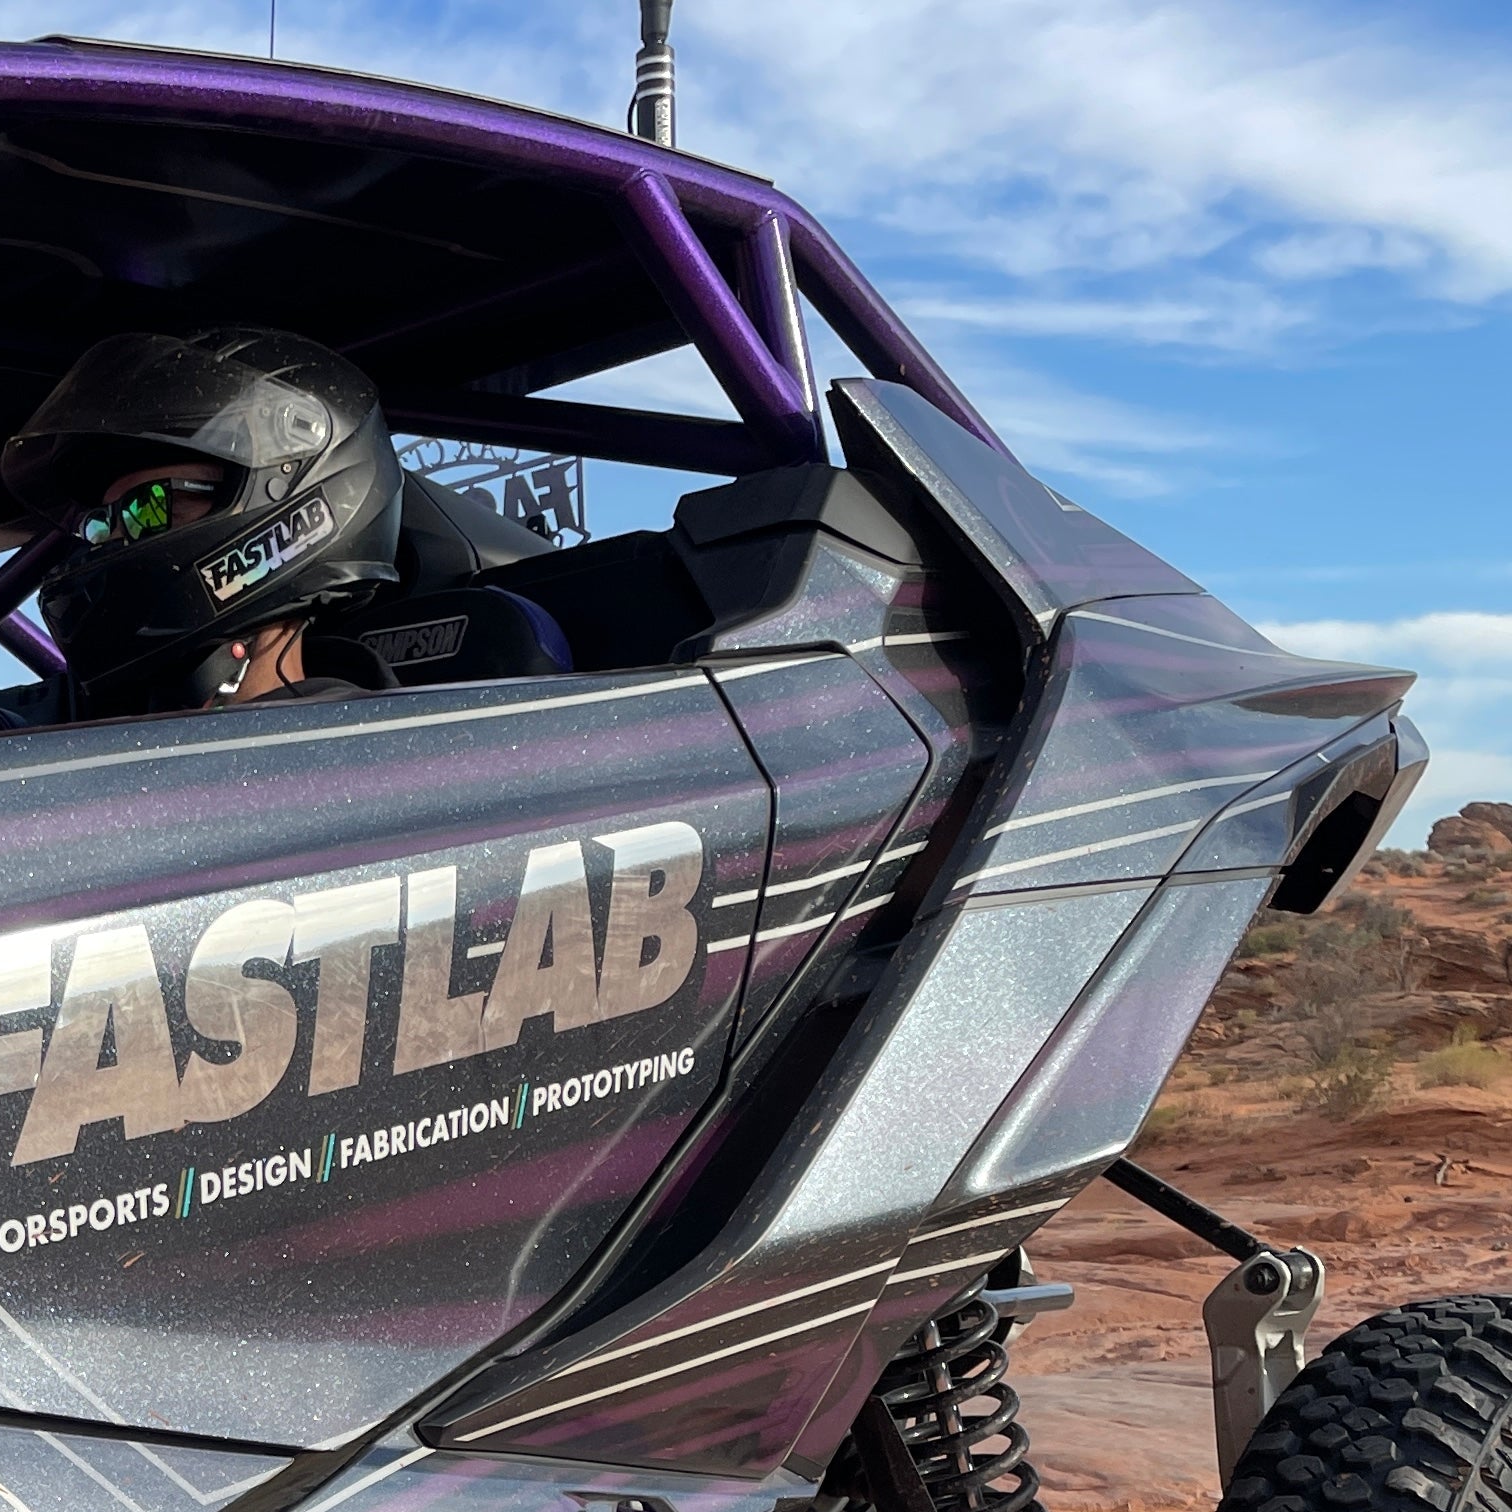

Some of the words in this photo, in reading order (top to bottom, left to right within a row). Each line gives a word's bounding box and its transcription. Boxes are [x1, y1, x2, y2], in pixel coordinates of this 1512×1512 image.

[201, 498, 334, 601] FASTLAB
[199, 1147, 312, 1205] DESIGN
[339, 1096, 510, 1169] FABRICATION
[532, 1047, 696, 1117] PROTOTYPING
